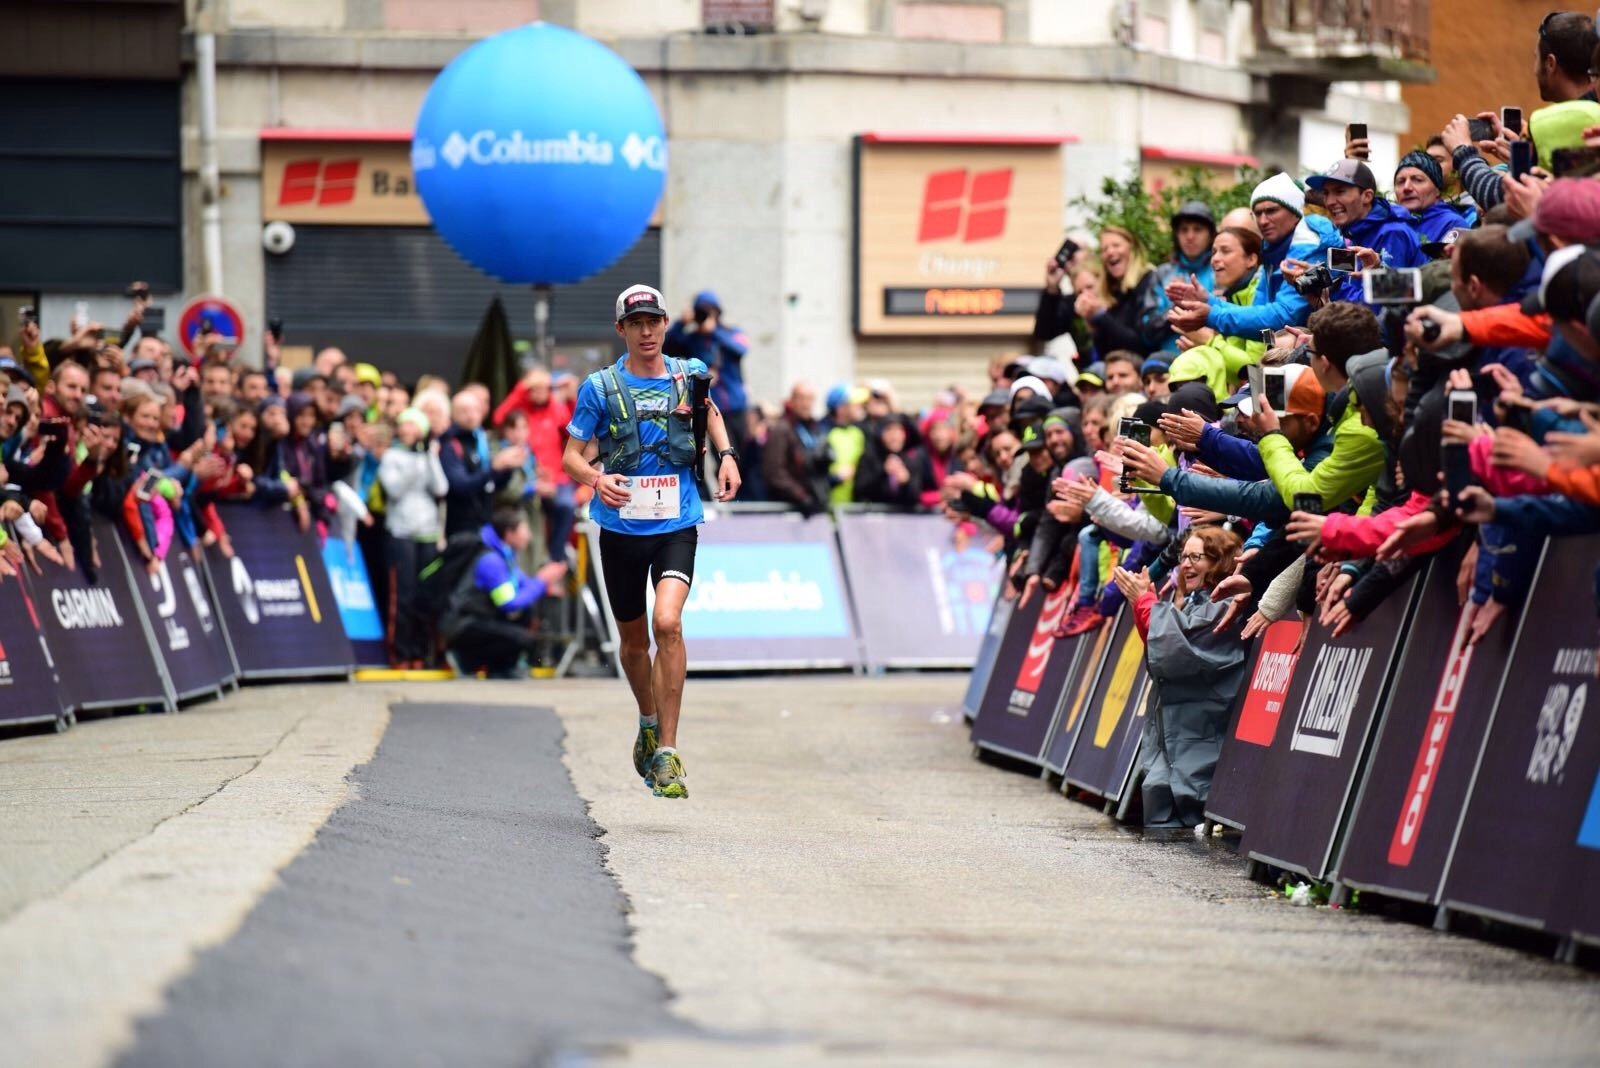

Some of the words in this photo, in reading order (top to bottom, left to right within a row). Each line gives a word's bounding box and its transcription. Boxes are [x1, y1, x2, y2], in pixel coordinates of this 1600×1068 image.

[469, 130, 614, 165] Columbia
[640, 477, 677, 489] UTMB
[655, 489, 661, 500] 1
[52, 588, 124, 630] GARMIN
[1290, 643, 1374, 759] CAMELBAK
